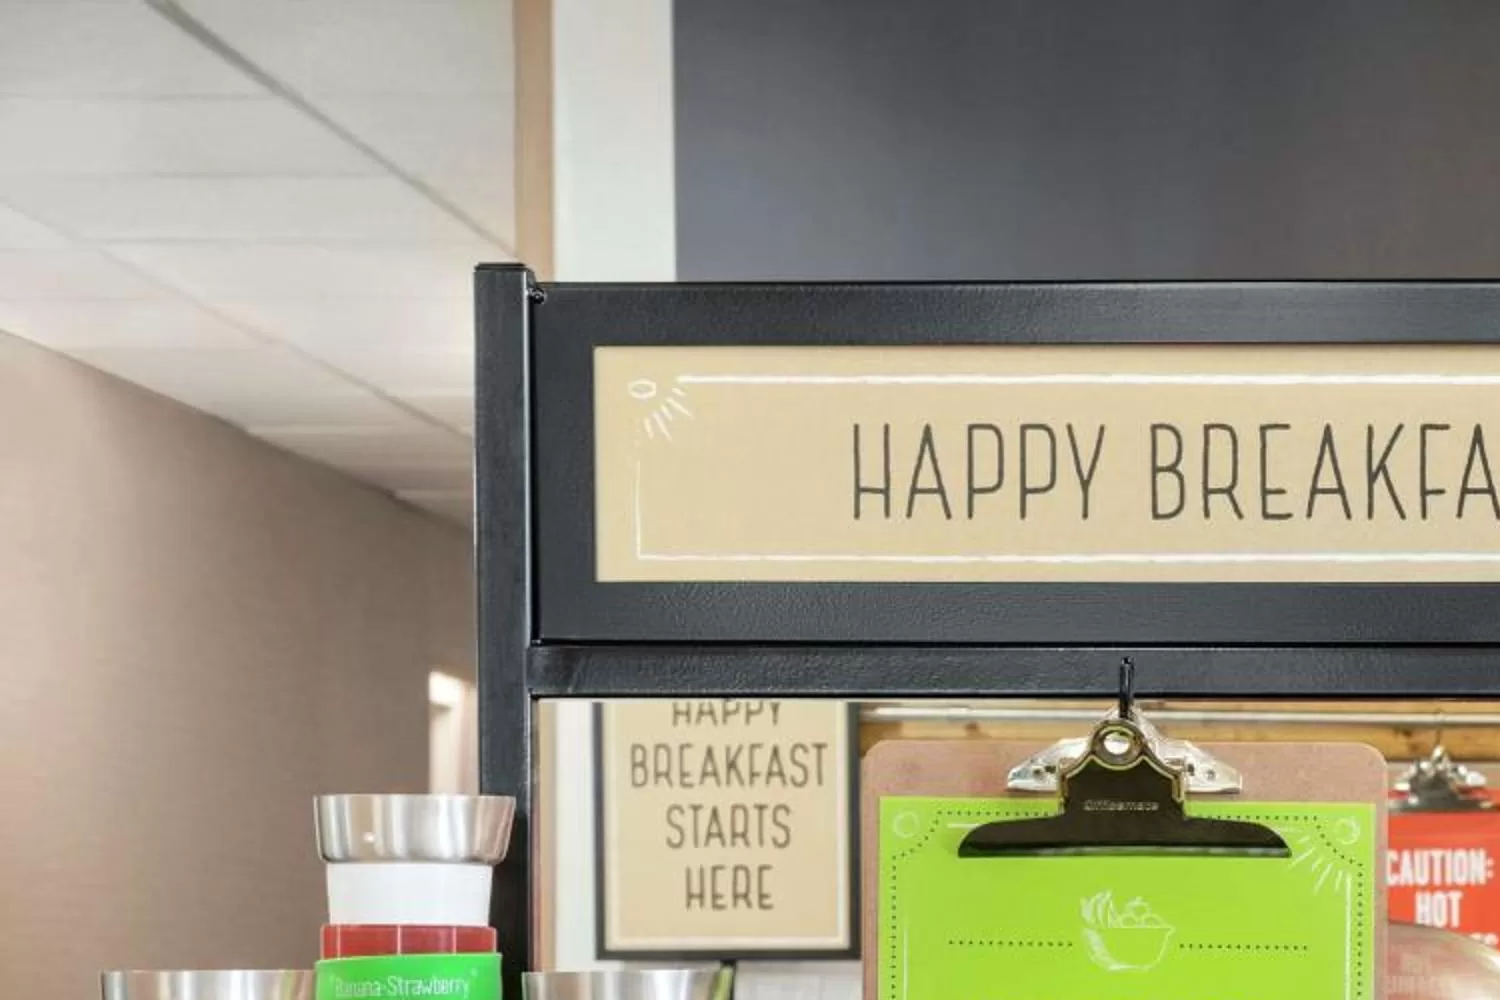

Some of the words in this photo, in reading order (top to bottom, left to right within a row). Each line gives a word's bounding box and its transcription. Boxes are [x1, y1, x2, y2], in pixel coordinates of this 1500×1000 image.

[853, 423, 1105, 520] HAPPY
[630, 743, 828, 788] BREAKFAST
[665, 803, 792, 849] STARTS
[685, 864, 775, 911] HERE
[1385, 848, 1495, 886] CAUTION:
[1415, 891, 1464, 928] HOT
